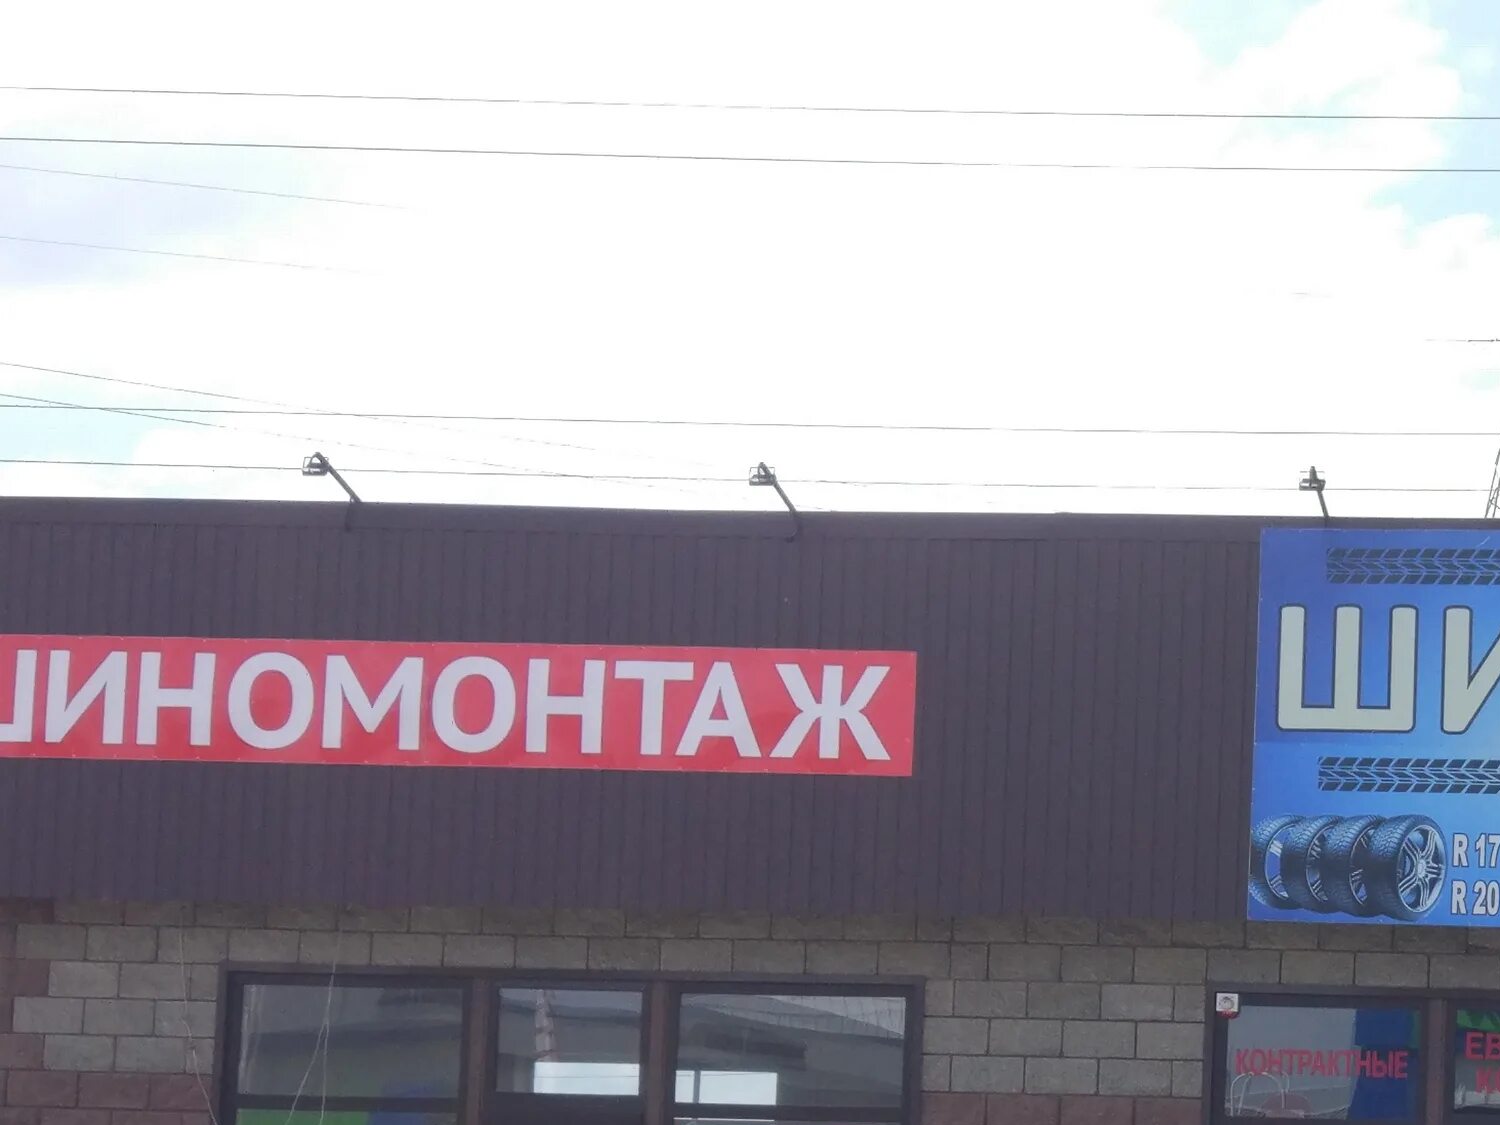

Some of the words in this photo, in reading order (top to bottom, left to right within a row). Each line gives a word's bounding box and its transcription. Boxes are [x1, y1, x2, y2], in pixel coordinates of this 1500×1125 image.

[1453, 833, 1469, 867] R
[1451, 880, 1467, 915] R
[1472, 880, 1500, 916] 20
[1235, 1048, 1408, 1079] КОНТРАКТНЫЕ
